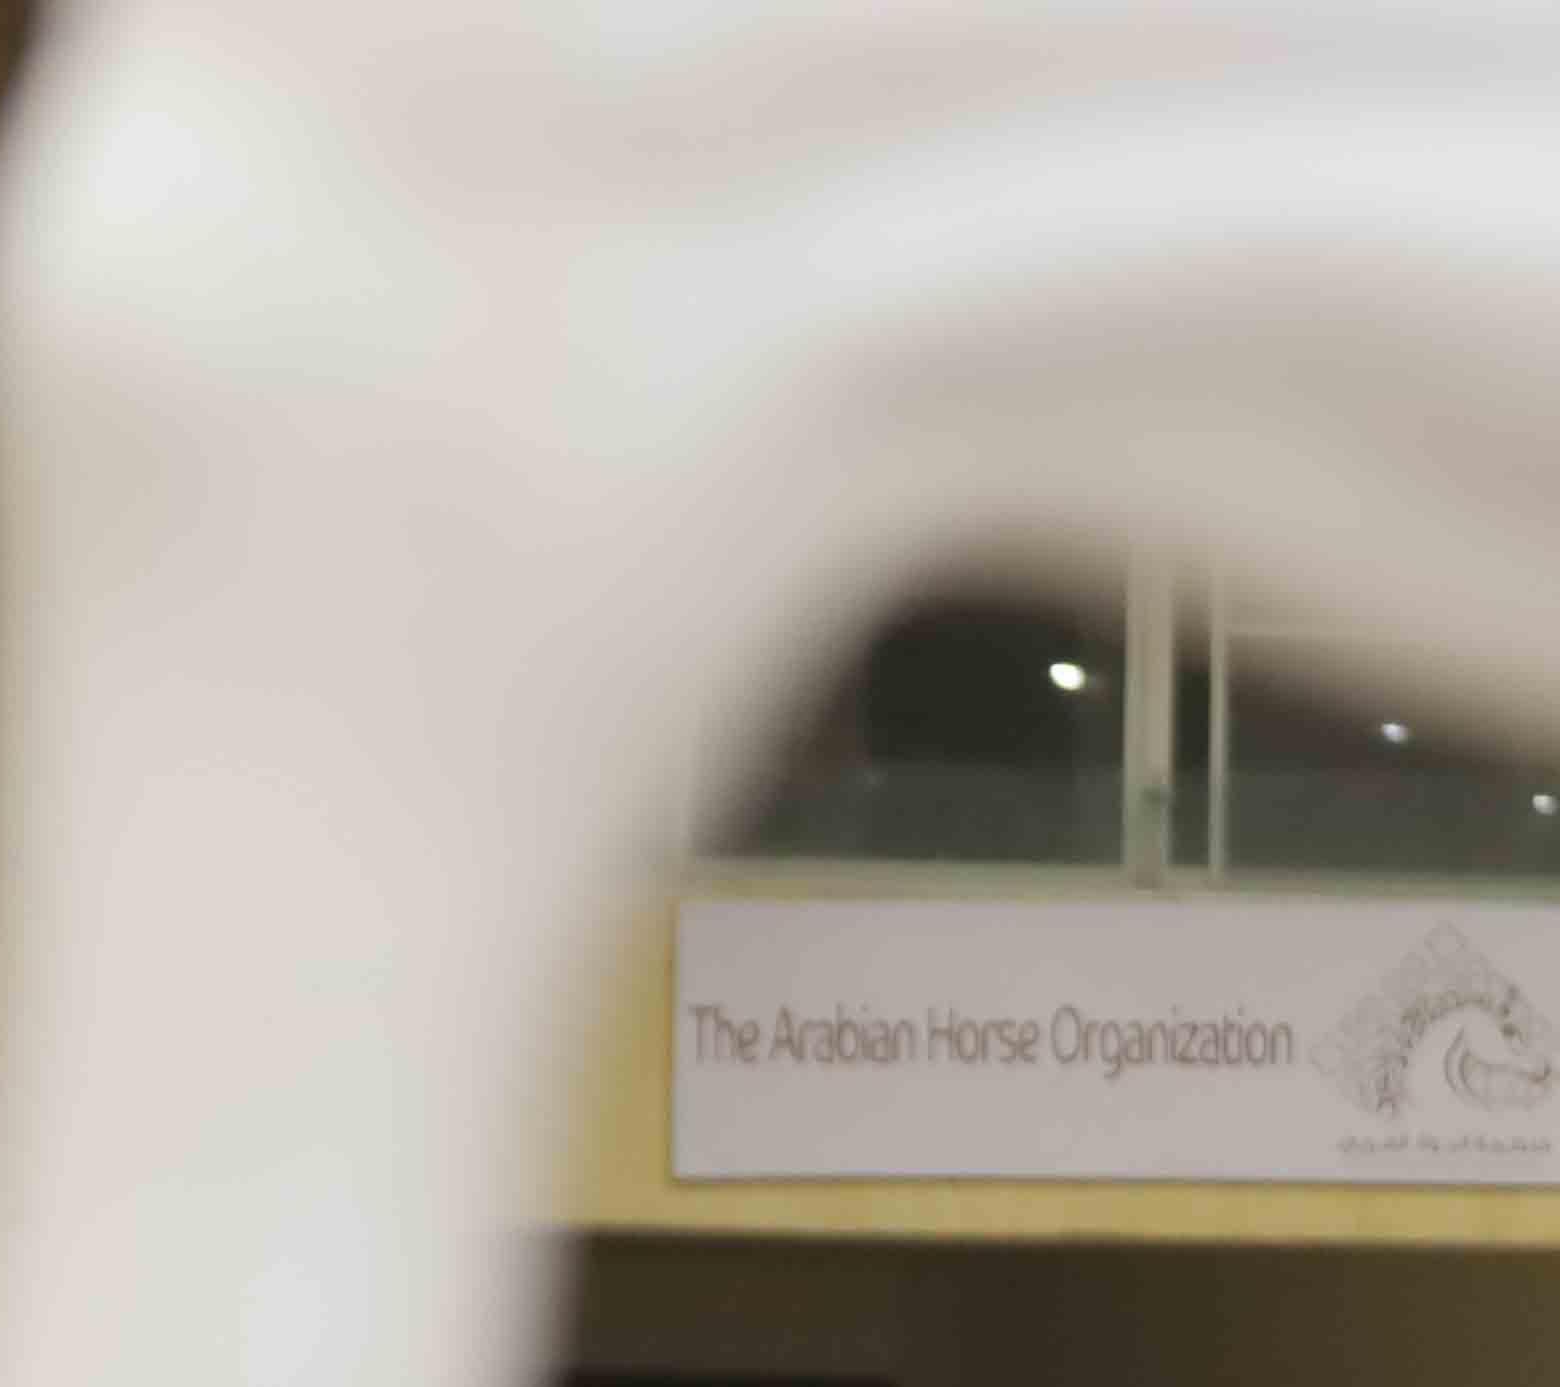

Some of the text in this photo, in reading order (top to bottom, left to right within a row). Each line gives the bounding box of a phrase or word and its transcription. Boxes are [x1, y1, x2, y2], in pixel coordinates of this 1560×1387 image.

[690, 1002, 1294, 1082] The Arabian Horse Organization
